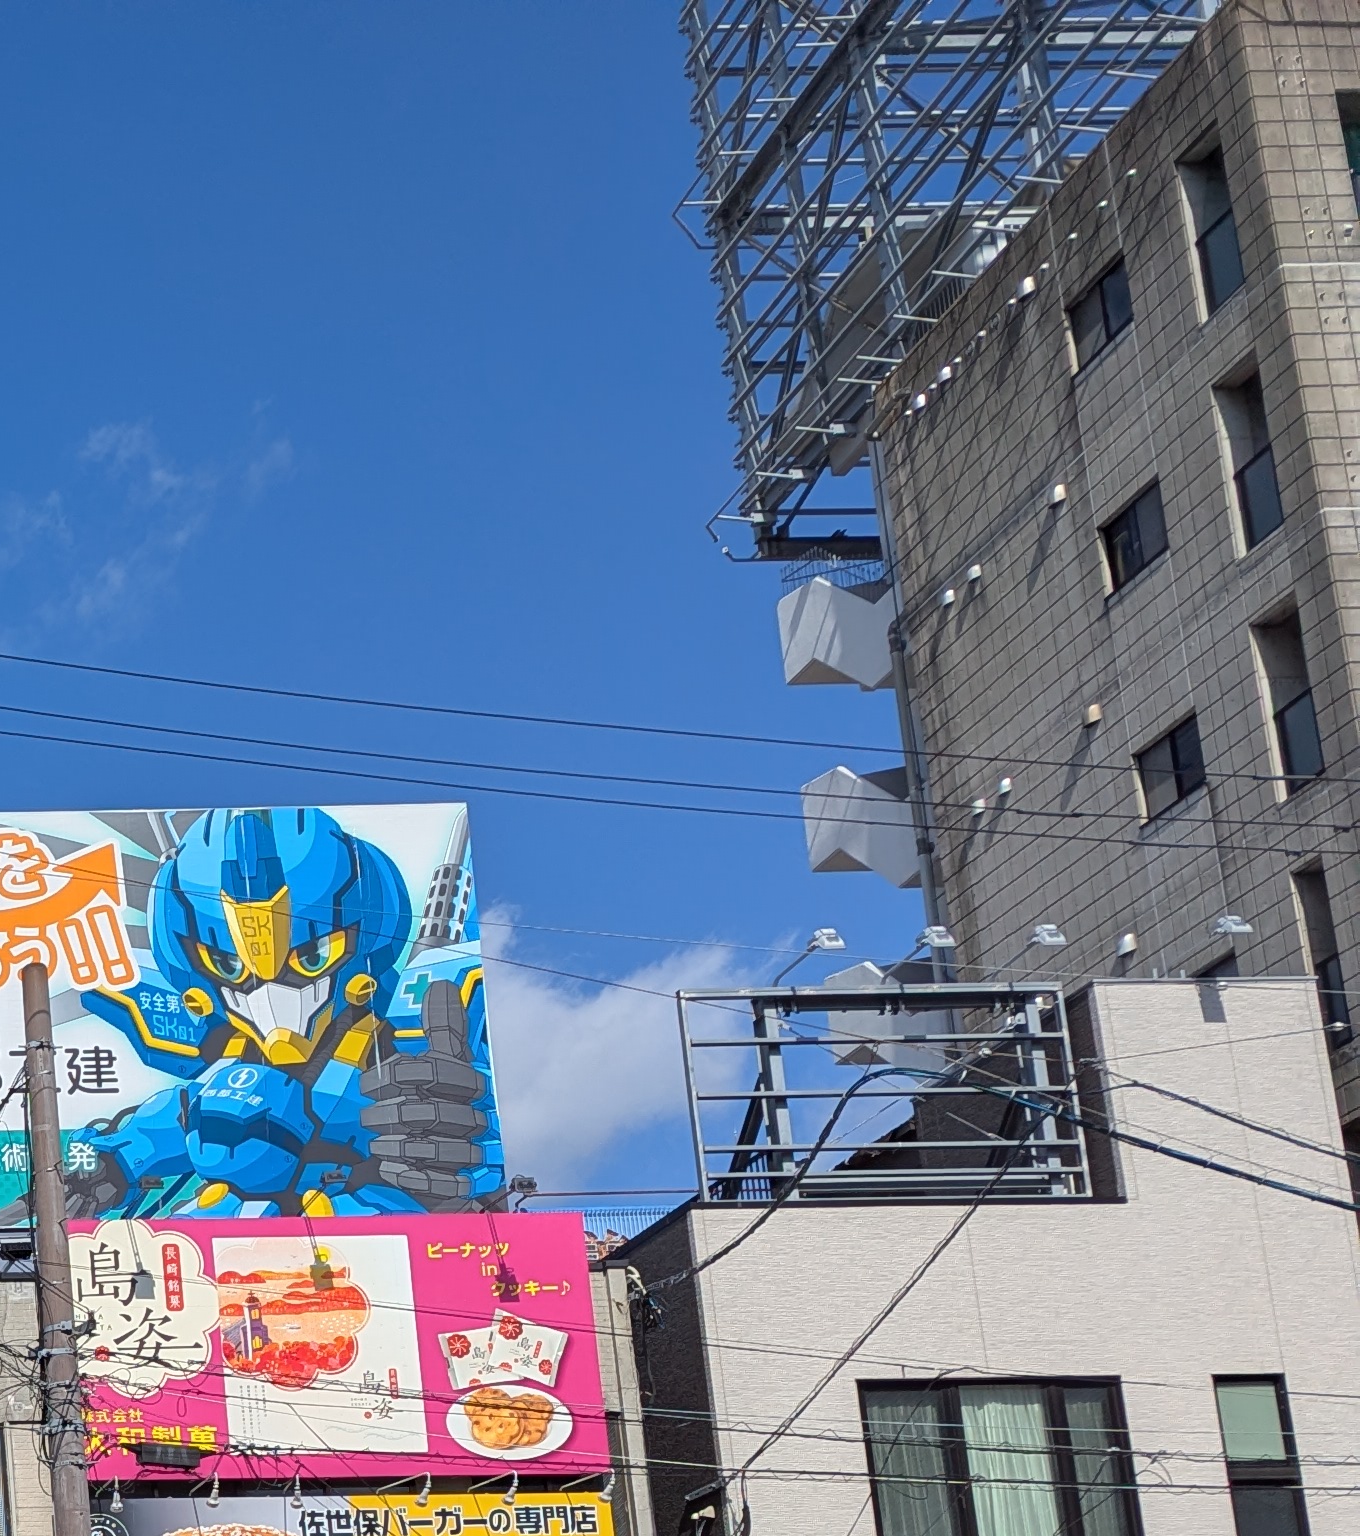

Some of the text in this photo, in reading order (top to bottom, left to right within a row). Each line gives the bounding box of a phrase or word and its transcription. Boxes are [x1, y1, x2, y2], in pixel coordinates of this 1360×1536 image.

[242, 915, 271, 937] SK
[139, 990, 186, 1014] 安全第
[427, 1242, 509, 1258] ピーナッツ
[481, 1262, 498, 1276] in
